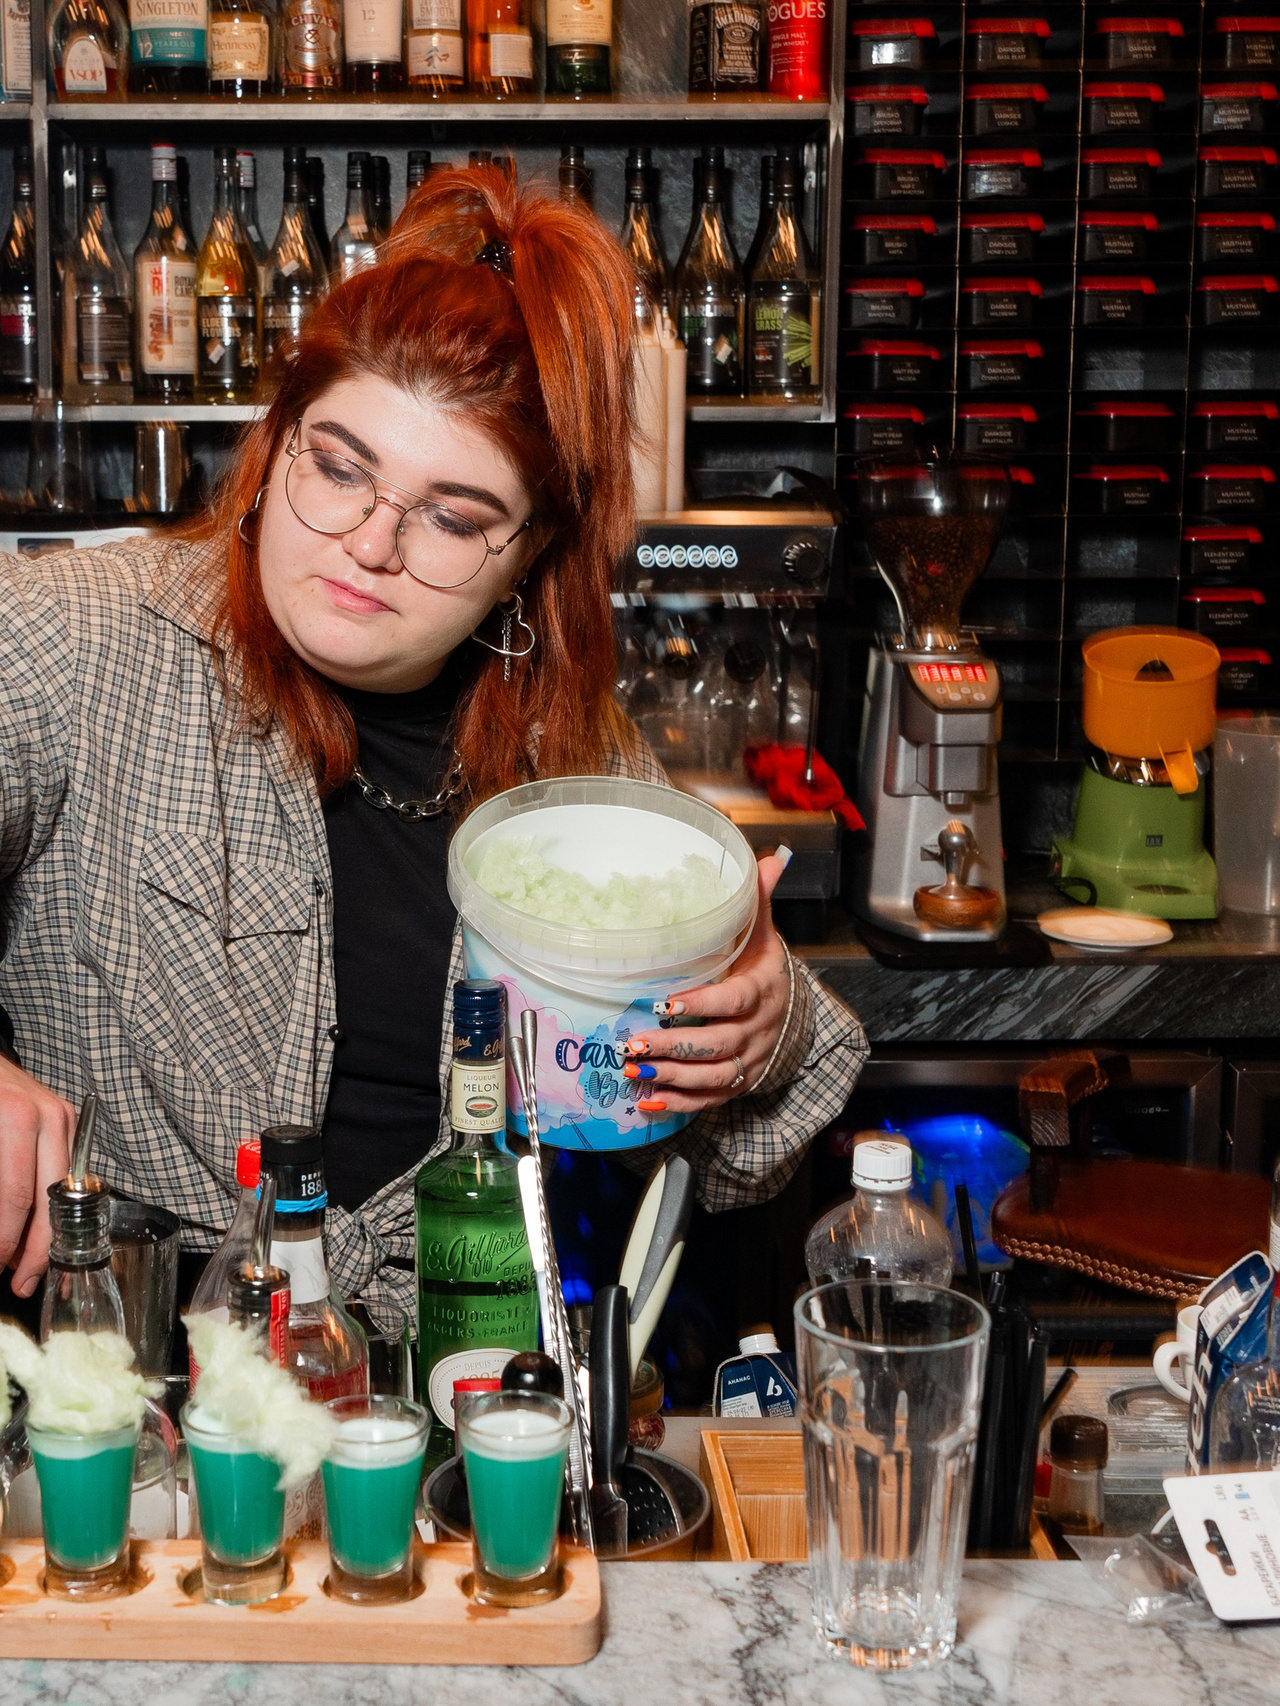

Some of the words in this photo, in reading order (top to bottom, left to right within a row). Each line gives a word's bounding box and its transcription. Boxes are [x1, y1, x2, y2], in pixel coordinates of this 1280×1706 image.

[137, 2, 202, 17] SINGLETON
[361, 9, 376, 21] 12
[768, 2, 826, 22] OGUES
[139, 42, 154, 58] 12
[213, 41, 258, 51] Hennessy
[69, 69, 103, 81] VSOP
[755, 308, 783, 320] LEMON
[755, 320, 782, 332] GRASS
[463, 1083, 500, 1093] MELON
[301, 1179, 322, 1197] 188
[446, 1228, 528, 1284] Giffar
[464, 1360, 492, 1372] DEPUIS
[727, 1375, 751, 1386] АНАНАС
